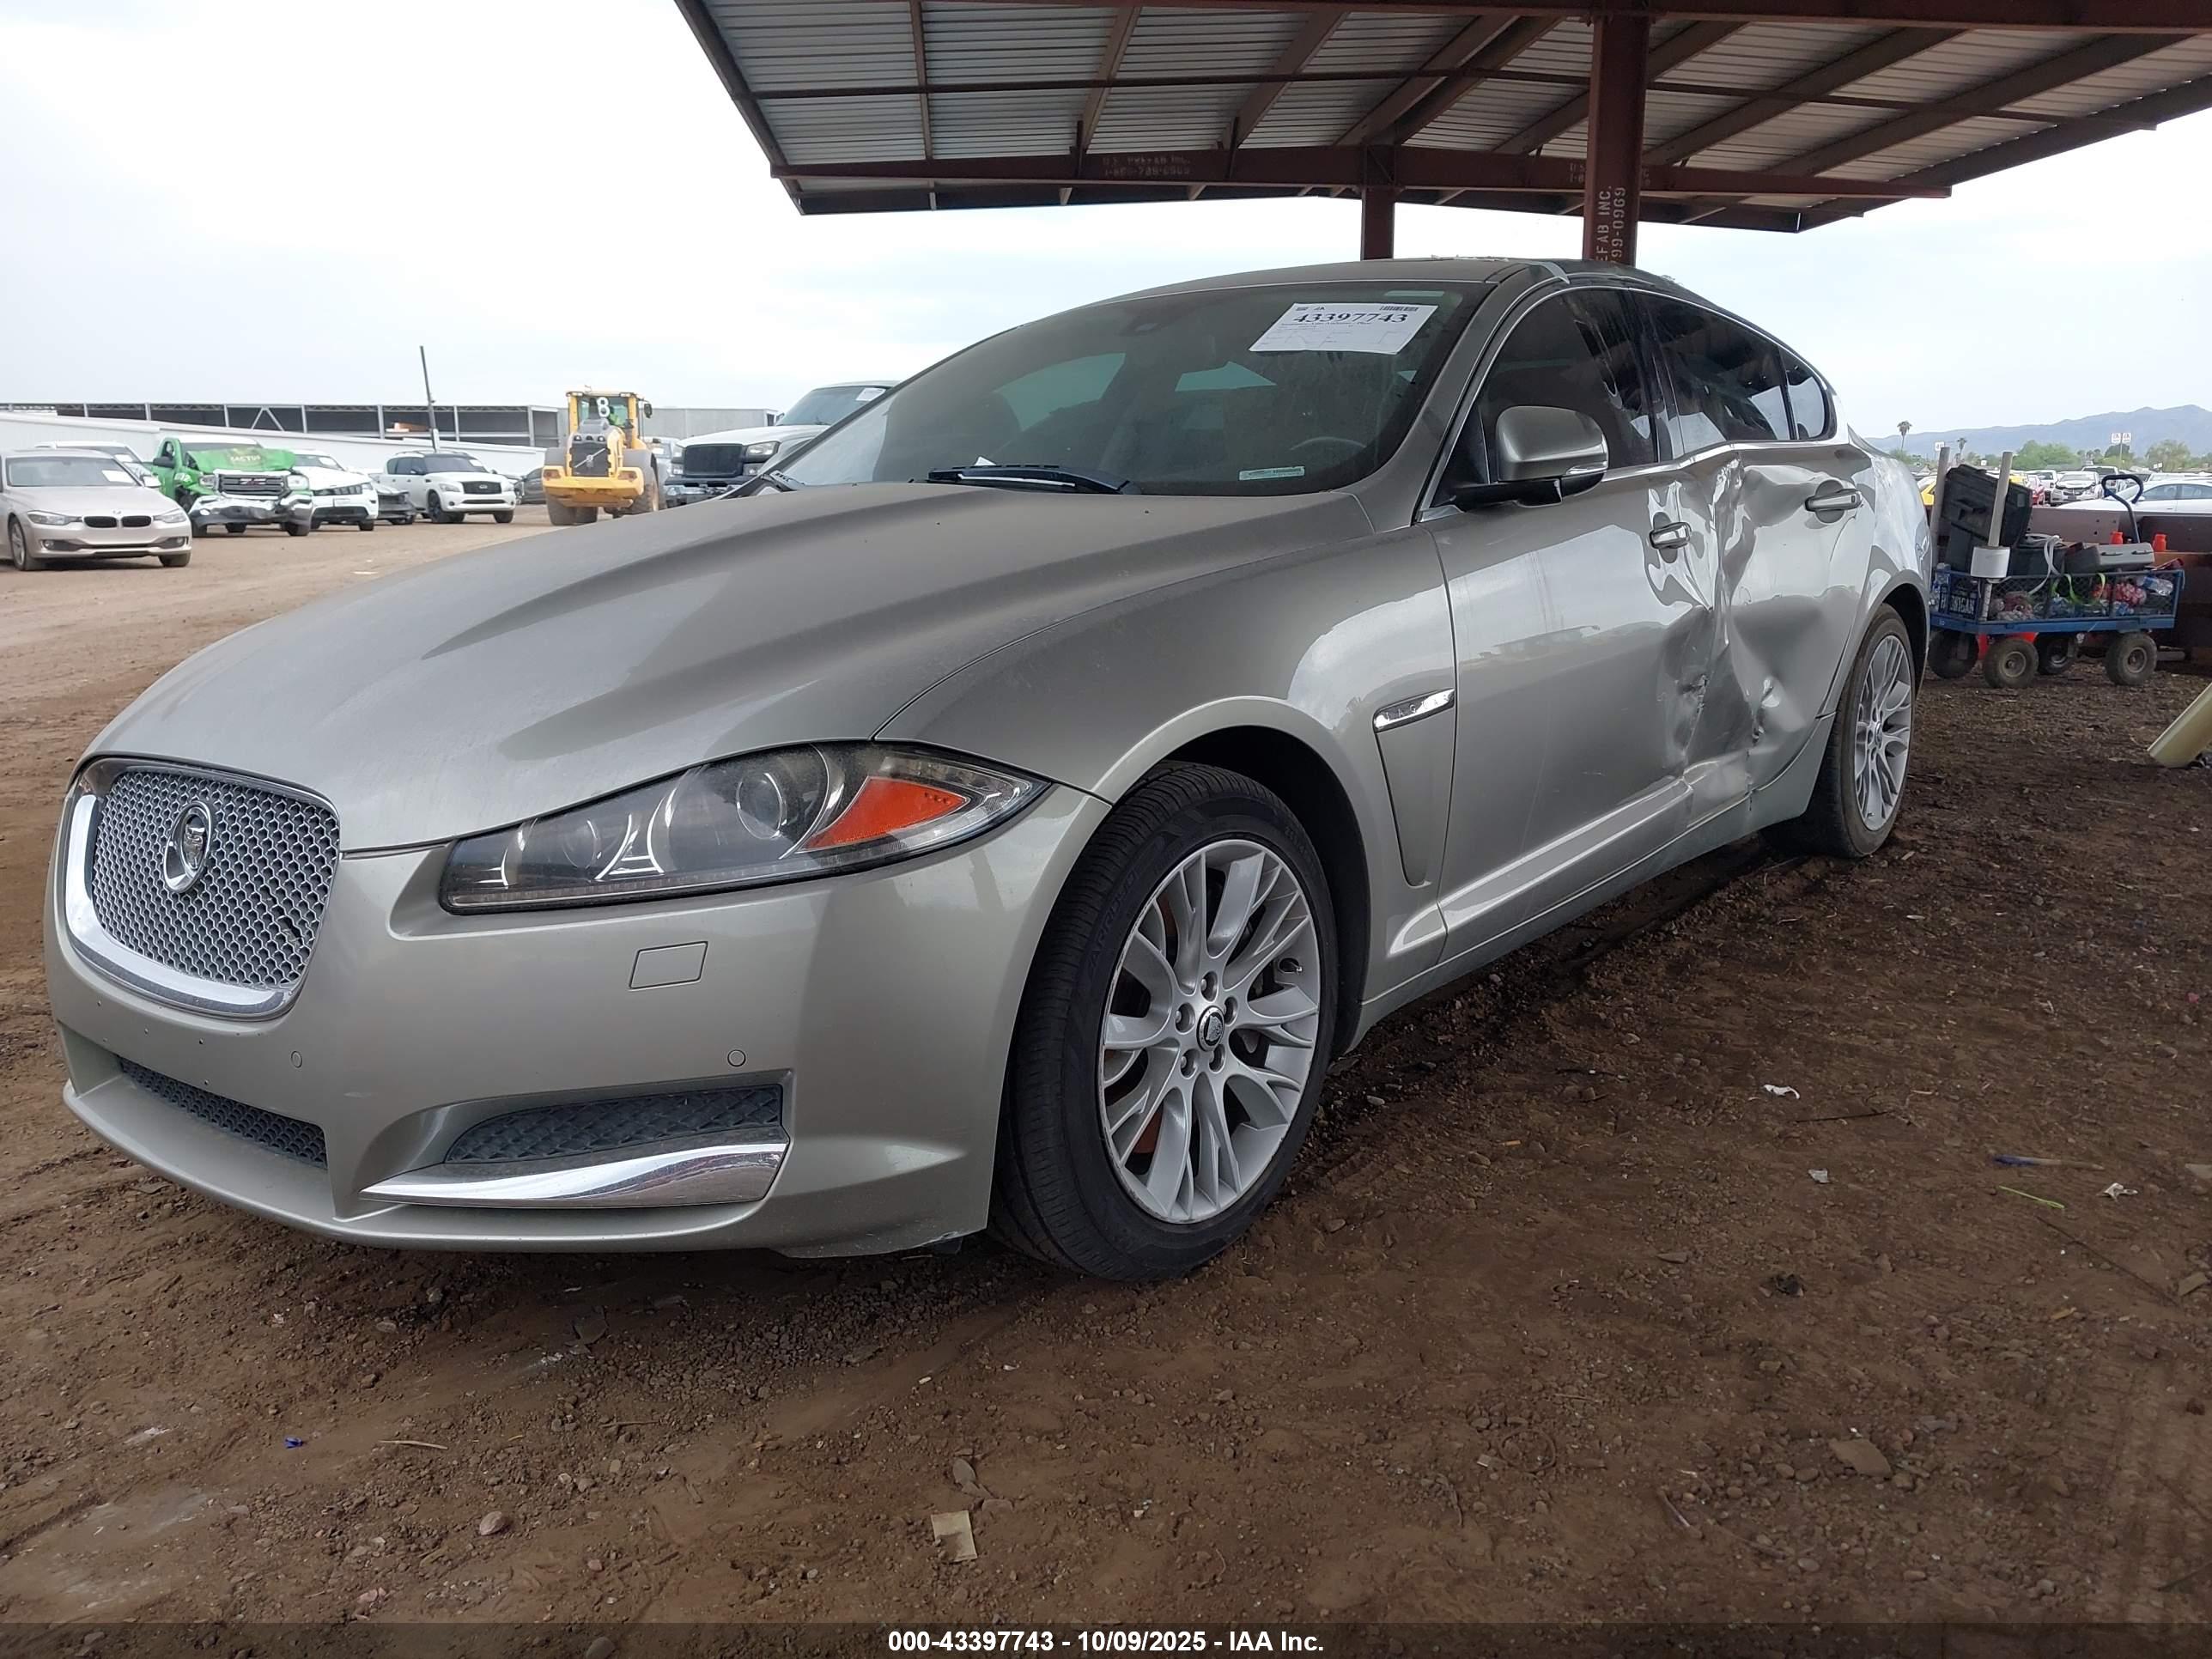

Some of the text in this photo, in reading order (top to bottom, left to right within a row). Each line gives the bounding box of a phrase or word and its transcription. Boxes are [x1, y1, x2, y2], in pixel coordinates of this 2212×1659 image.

[1597, 185, 1611, 216] INC.
[1292, 313, 1407, 323] 43397743
[596, 396, 611, 418] 8
